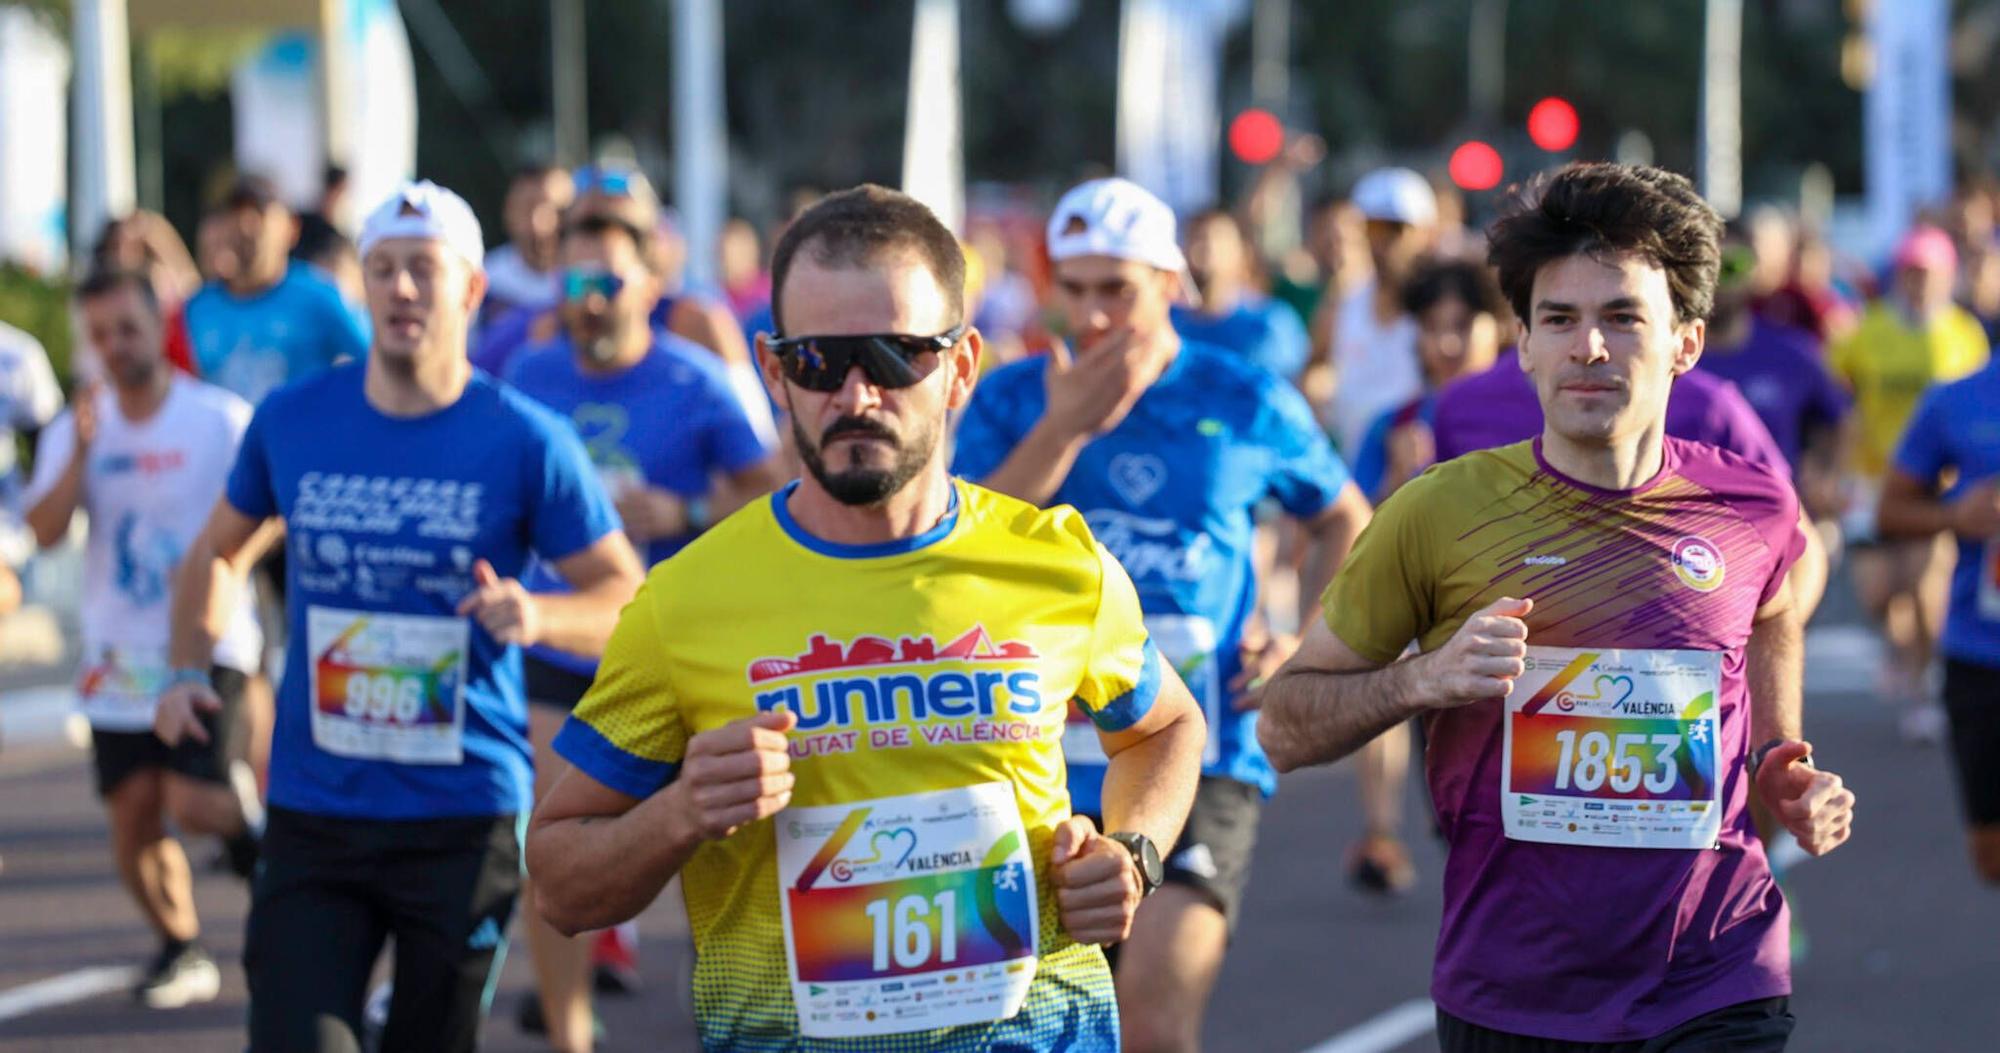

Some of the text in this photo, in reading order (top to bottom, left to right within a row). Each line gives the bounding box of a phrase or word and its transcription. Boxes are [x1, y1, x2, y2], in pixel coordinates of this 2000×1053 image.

[345, 673, 422, 721] 996
[756, 671, 1041, 729] runners
[871, 729, 909, 748] DE
[922, 720, 1040, 742] VALÈNCIA
[1555, 730, 1681, 794] 1853
[907, 851, 971, 873] VALÈNCIA
[865, 890, 957, 972] 161
